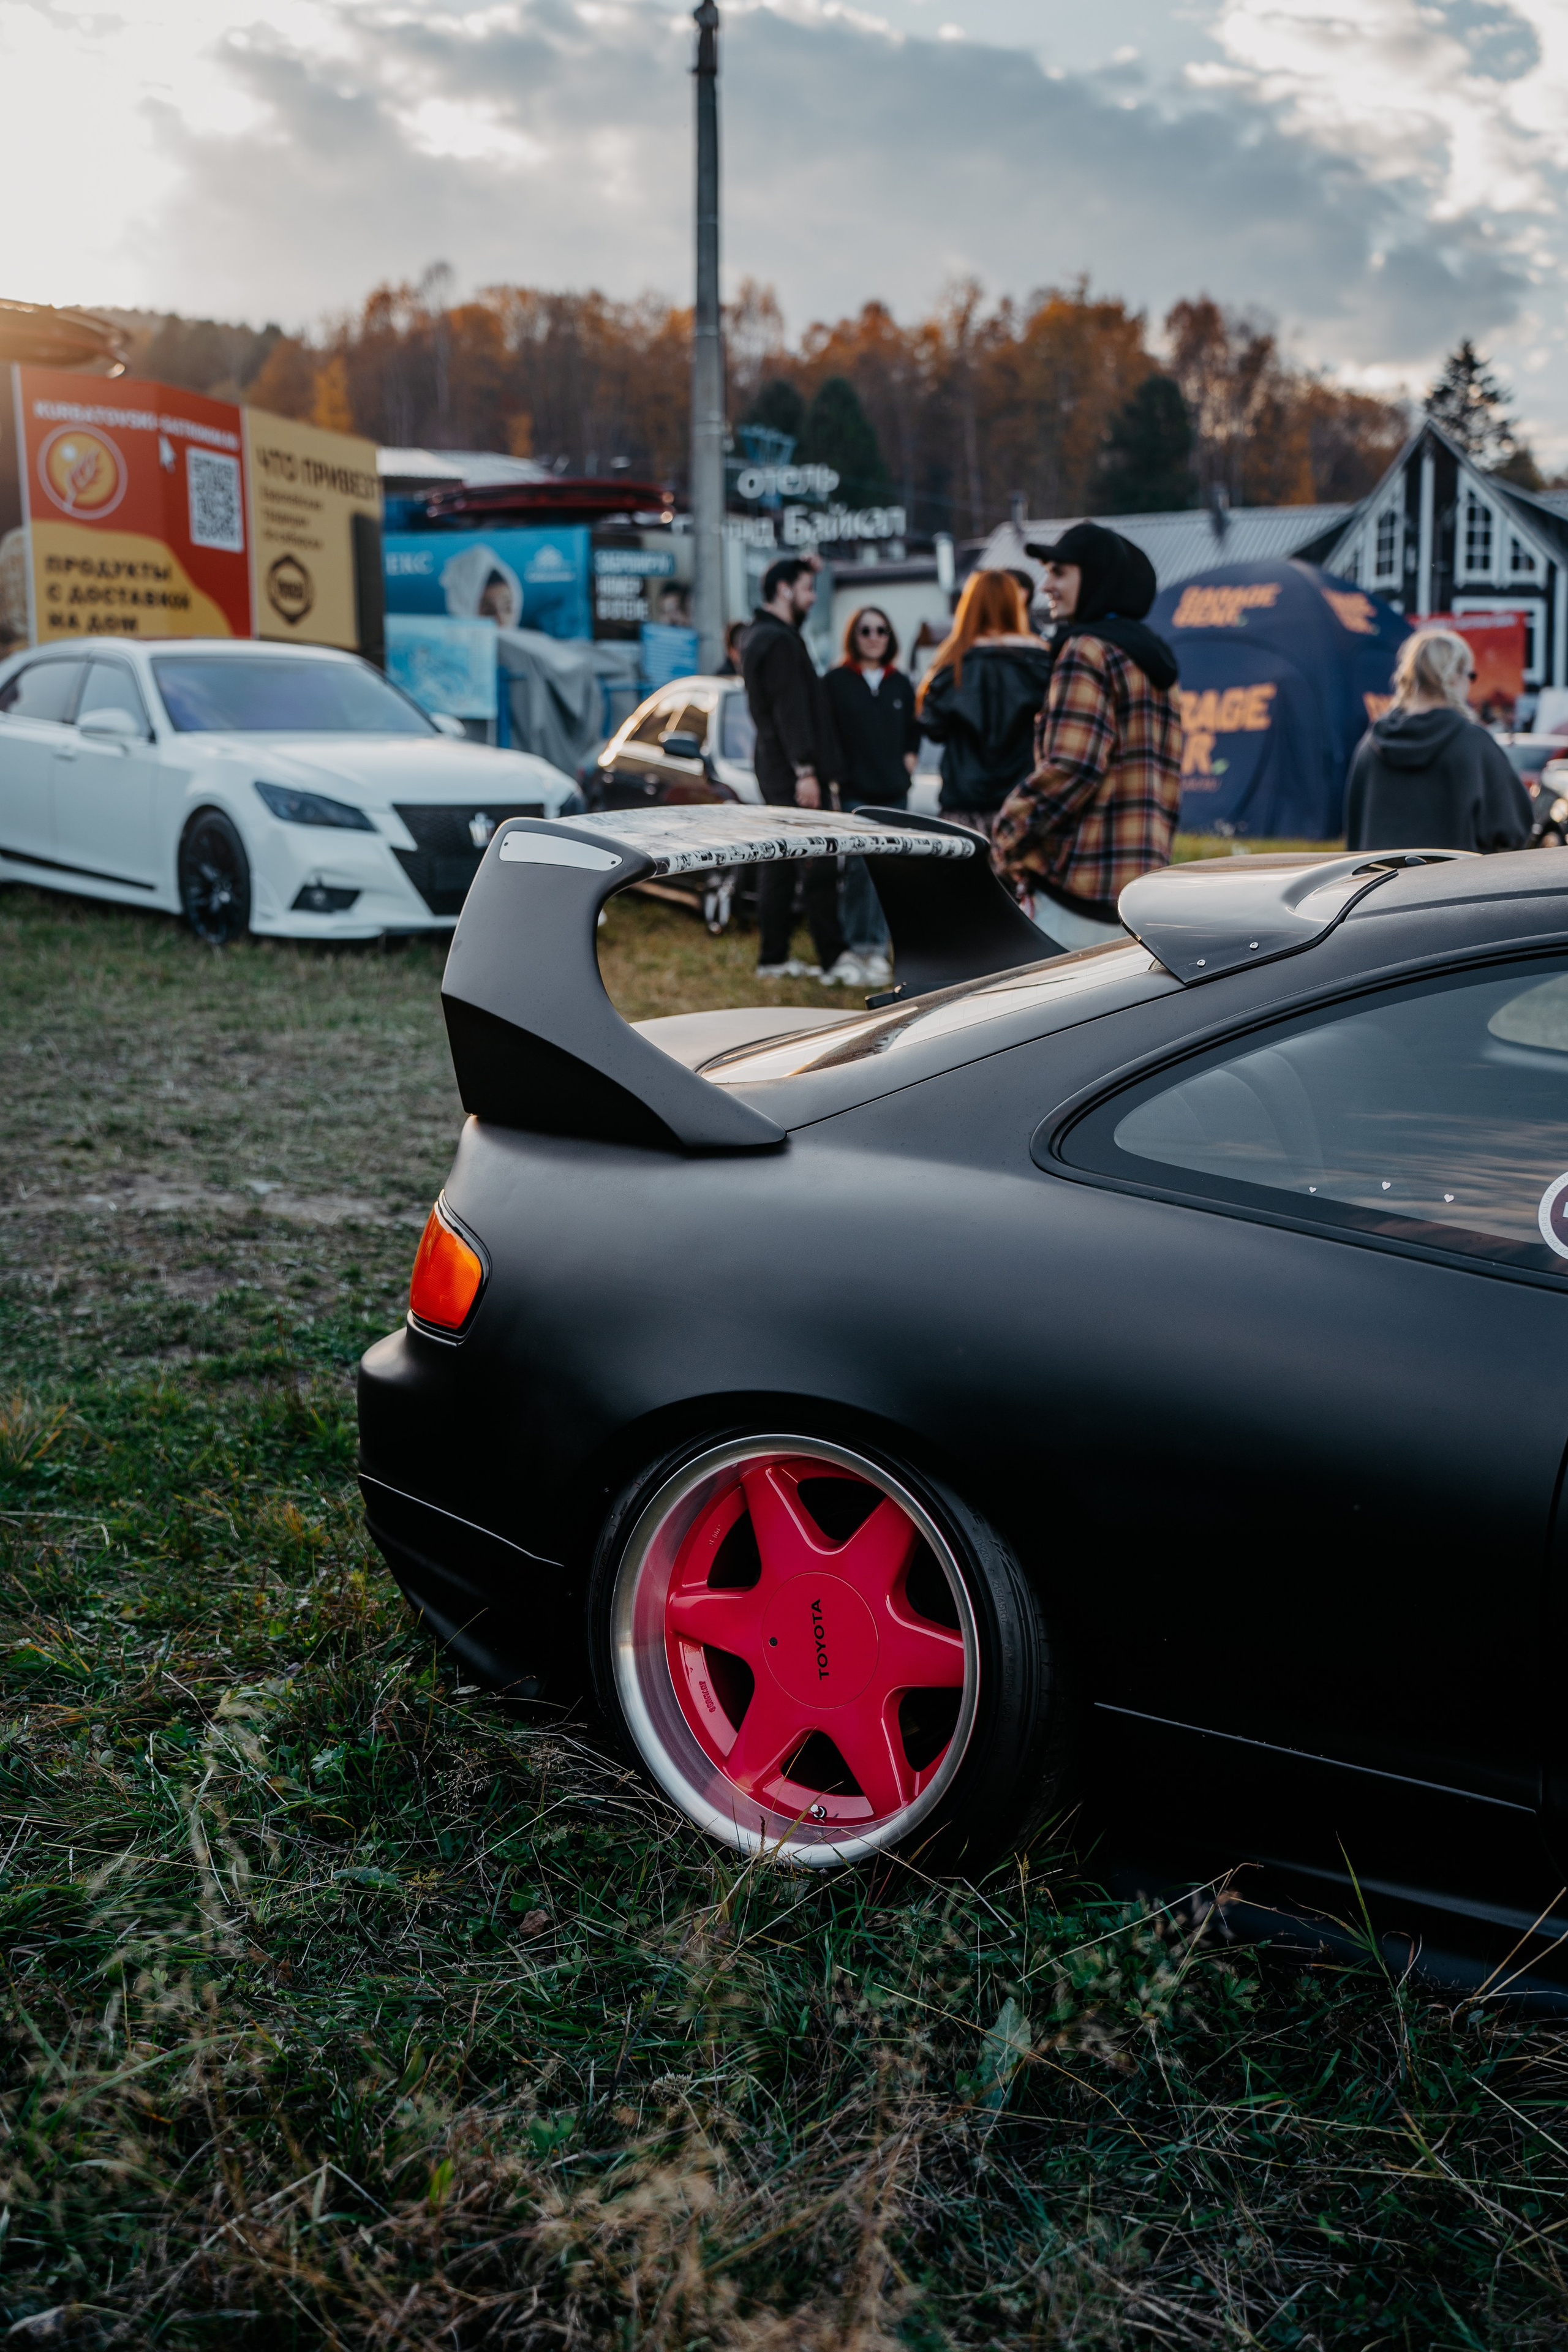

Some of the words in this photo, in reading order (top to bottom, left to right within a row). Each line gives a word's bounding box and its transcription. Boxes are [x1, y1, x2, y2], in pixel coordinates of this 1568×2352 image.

[784, 501, 907, 545] Байкал
[46, 554, 171, 580] ПРОДУКТЫ
[67, 583, 191, 611] ДОСТАВКОЙ
[47, 611, 78, 631] НА
[86, 612, 138, 634] ДОМ
[1179, 682, 1277, 733] RAGE
[1541, 1194, 1553, 1215] CLUB
[1542, 1216, 1559, 1248] DRIVERS
[811, 1598, 829, 1681] TOYOTA
[698, 1681, 716, 1713] GERMANY
